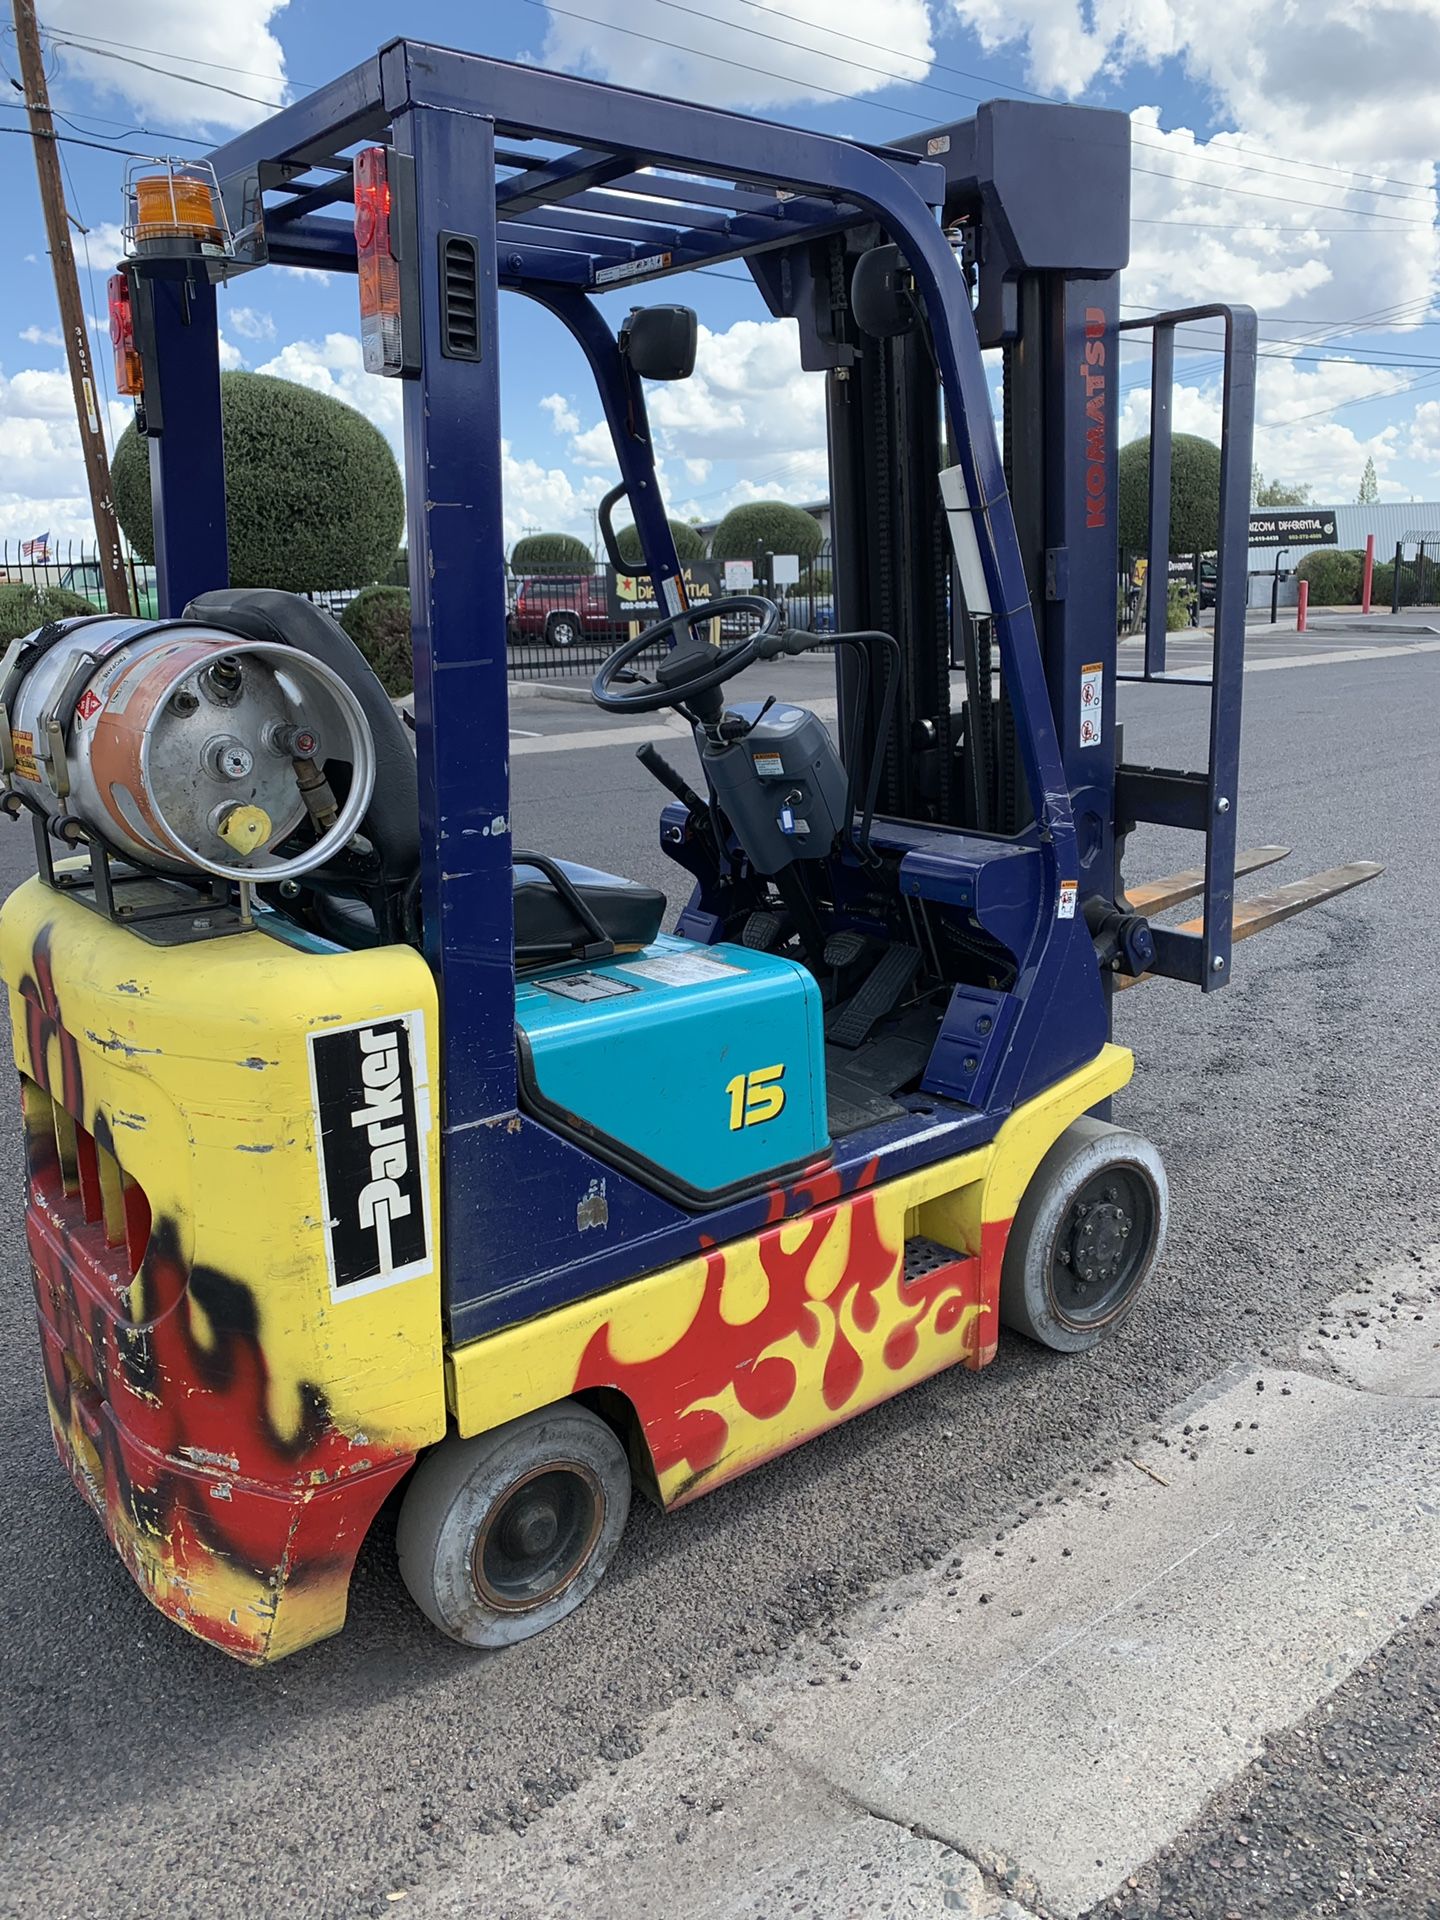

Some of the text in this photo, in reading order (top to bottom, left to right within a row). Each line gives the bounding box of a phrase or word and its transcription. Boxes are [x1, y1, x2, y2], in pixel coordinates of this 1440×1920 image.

[1080, 307, 1106, 529] KOMATSU
[1278, 519, 1322, 531] DIFFERENTIAL
[351, 1029, 411, 1275] Parker
[725, 1063, 786, 1132] 15
